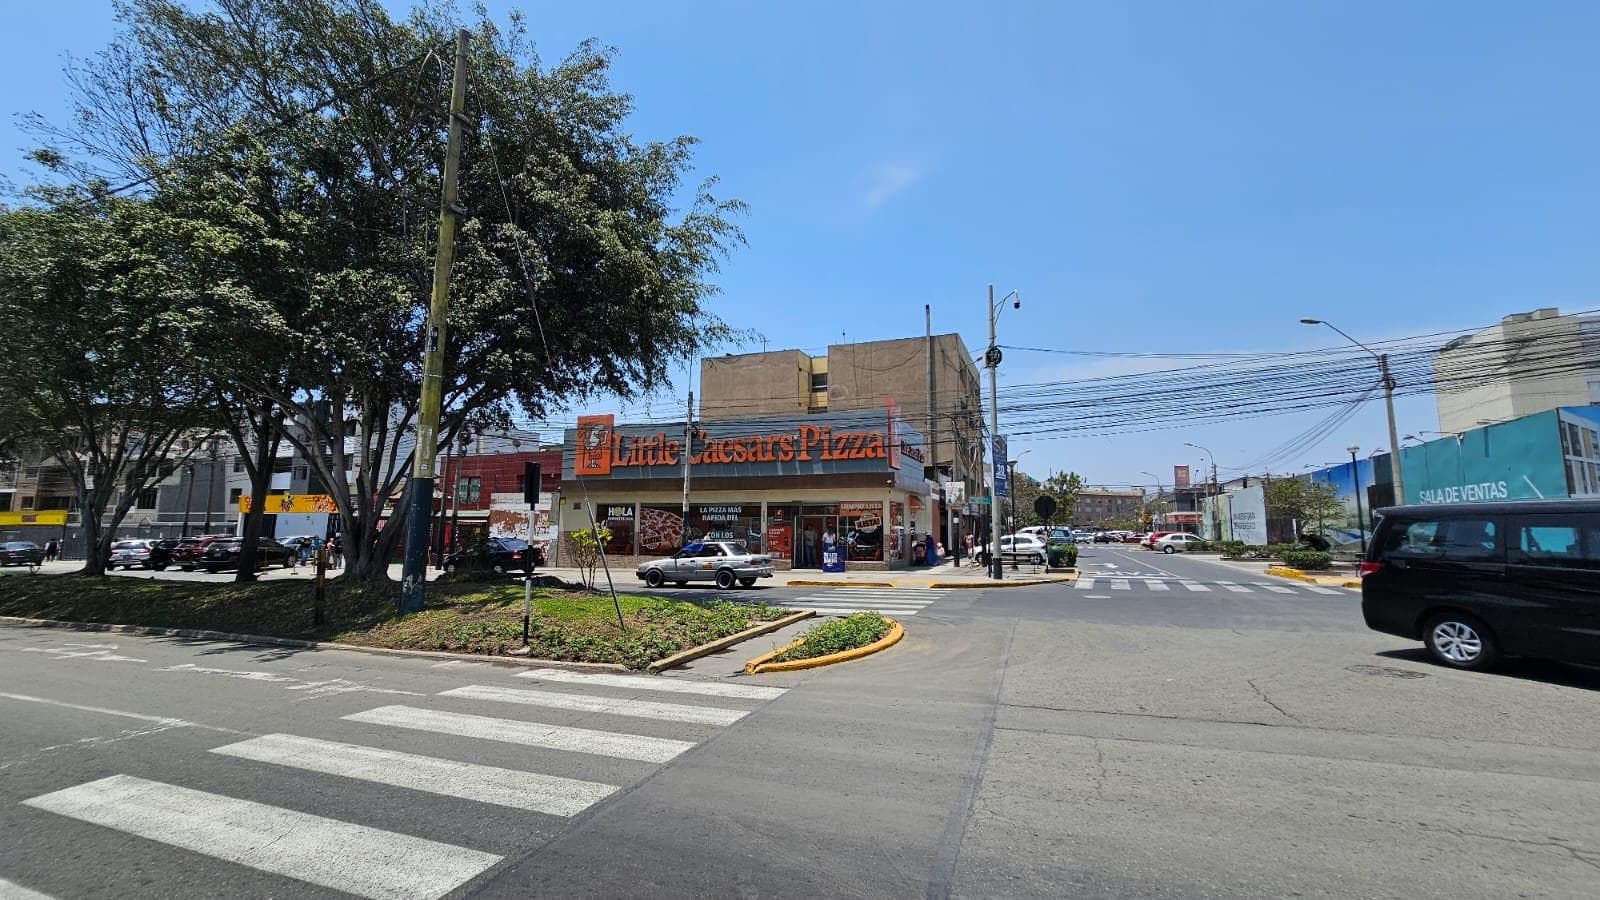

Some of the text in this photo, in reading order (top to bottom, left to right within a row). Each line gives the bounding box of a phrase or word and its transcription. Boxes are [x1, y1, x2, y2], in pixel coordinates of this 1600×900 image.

[611, 431, 680, 467] Little
[798, 424, 886, 461] Pizza
[1420, 481, 1508, 504] SALA DE VENTAS
[608, 506, 633, 517] HOLA
[721, 531, 734, 539] LOS
